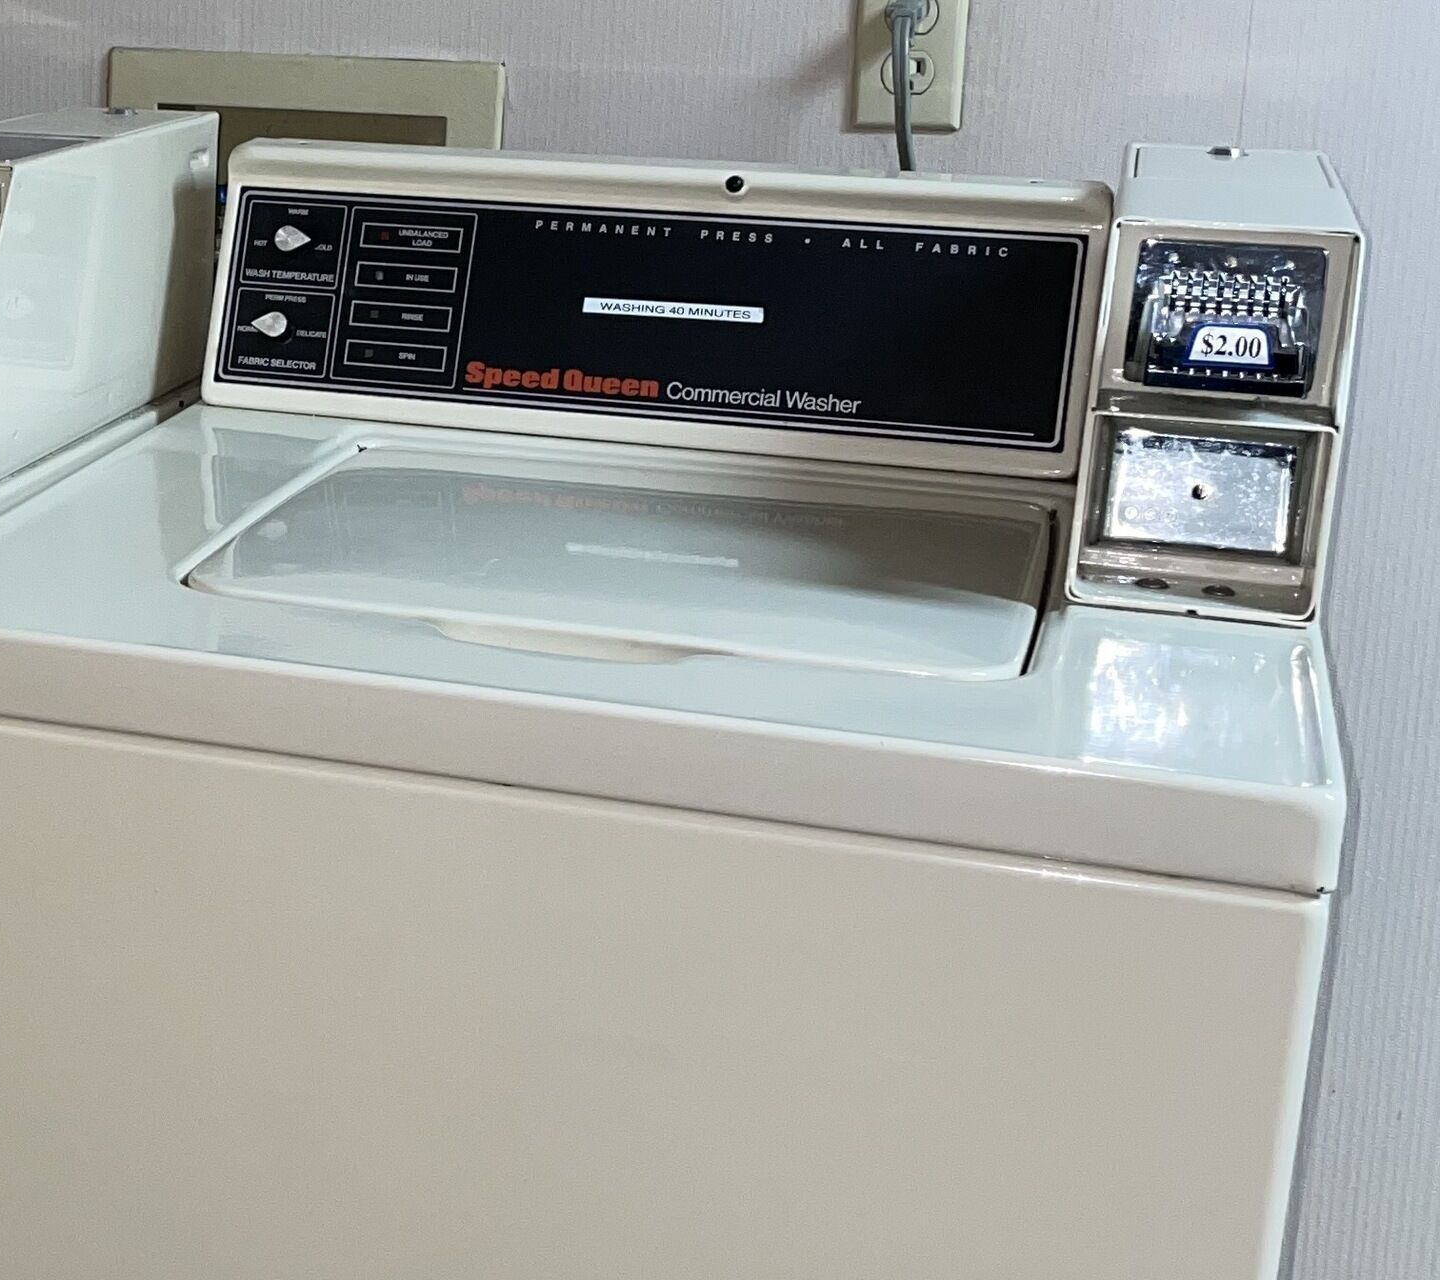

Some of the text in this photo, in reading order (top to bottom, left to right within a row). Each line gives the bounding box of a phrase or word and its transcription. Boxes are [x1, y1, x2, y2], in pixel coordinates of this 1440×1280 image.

[398, 228, 449, 239] UNBALANCED
[535, 220, 1009, 258] PERMANENT PRESS ALL FABRIC
[411, 238, 433, 247] LOAD
[245, 268, 335, 283] WASH TEMPERATURE
[600, 301, 752, 320] WASHING 40 MINUTES
[1200, 331, 1261, 358] $2.00
[237, 355, 317, 371] FABRIC SELECTOR
[465, 360, 862, 415] Speed Queen Commercial Washer
